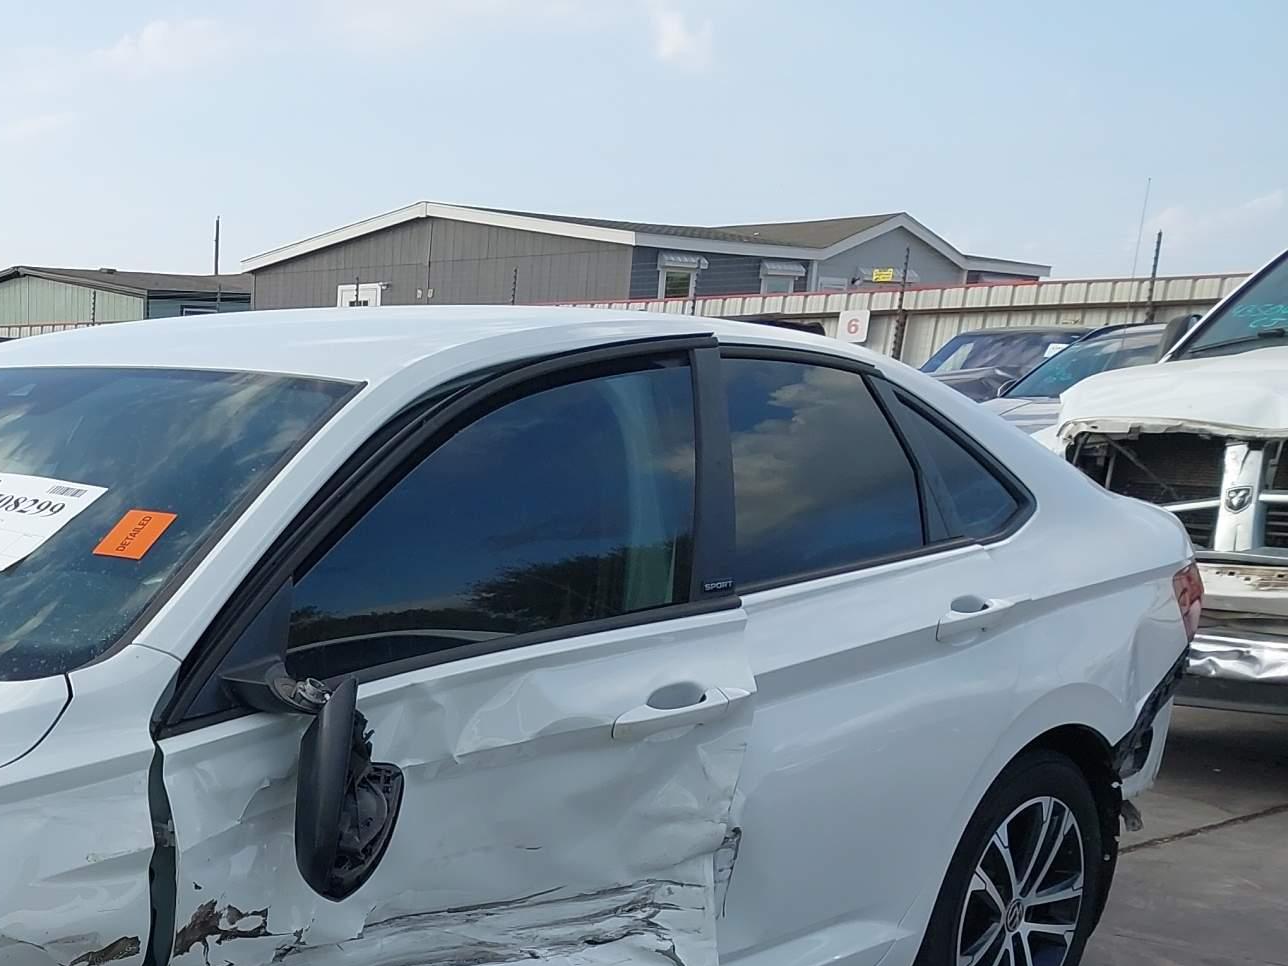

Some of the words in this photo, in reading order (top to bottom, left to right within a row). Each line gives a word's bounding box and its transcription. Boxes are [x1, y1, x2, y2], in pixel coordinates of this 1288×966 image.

[847, 318, 860, 335] 6
[115, 515, 152, 552] DETAILED
[704, 580, 733, 591] SPORT
